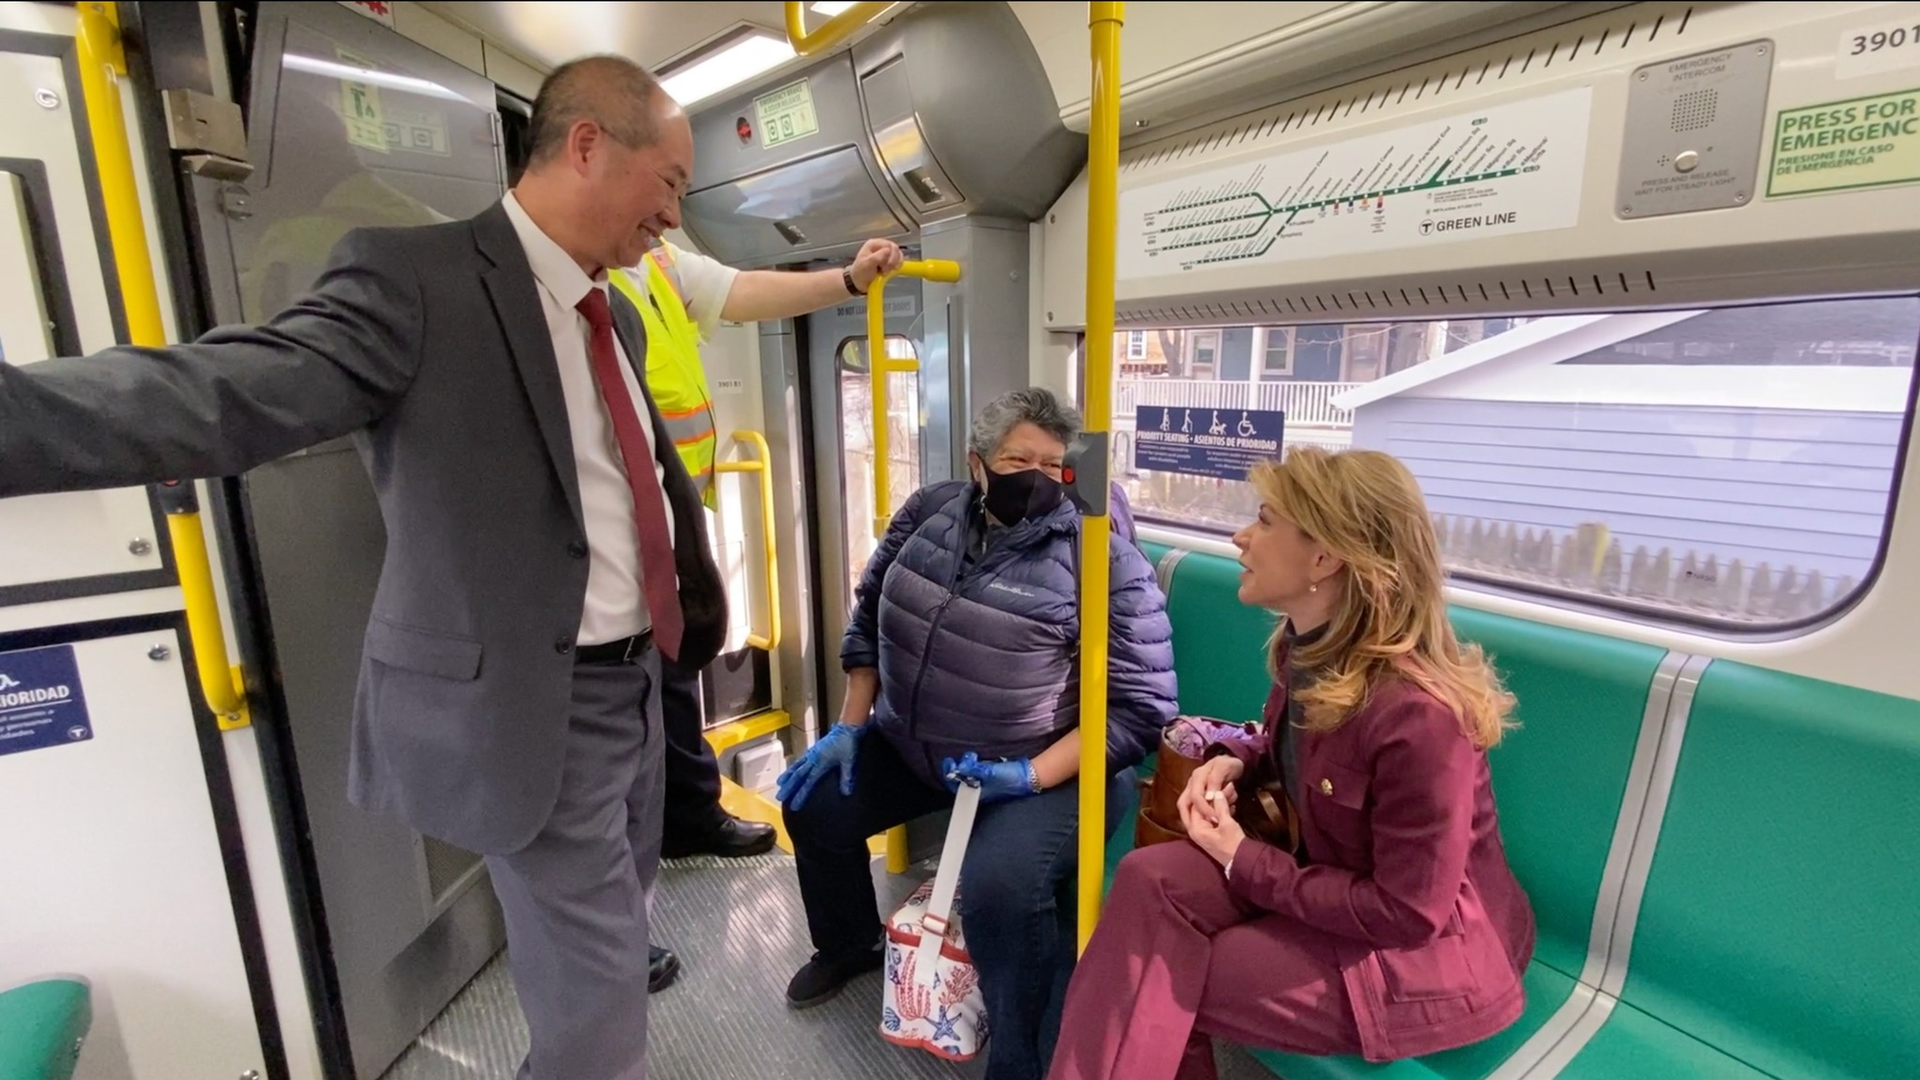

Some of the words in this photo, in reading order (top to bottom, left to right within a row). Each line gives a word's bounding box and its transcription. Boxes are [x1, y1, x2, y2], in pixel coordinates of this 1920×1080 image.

[1851, 24, 1920, 56] 3901
[1668, 53, 1734, 74] EMERGENCY
[1672, 64, 1727, 82] INTERCOM
[1782, 106, 1858, 134] PRESS
[1863, 98, 1917, 121] FOR
[1779, 117, 1920, 152] EMERGENC
[1776, 150, 1836, 166] PRESIONE
[1838, 147, 1856, 159] EN
[1858, 143, 1895, 156] CASO
[1775, 165, 1794, 176] DE
[1794, 155, 1876, 174] EMERGENCIA
[1634, 188, 1654, 197] WAIT
[1655, 184, 1673, 193] FOR
[1674, 180, 1708, 191] STEADY
[1709, 177, 1737, 187] LIGHT
[1641, 176, 1669, 187] PRESS
[1670, 175, 1688, 184] AND
[1690, 168, 1730, 181] RELEASE
[1436, 216, 1482, 232] GREEN
[1485, 211, 1517, 226] LINE
[1136, 430, 1164, 441] PRIORITY
[1164, 432, 1190, 444] SEATING
[1193, 434, 1226, 447] ASIENTOS
[1226, 436, 1236, 448] DE
[1236, 437, 1277, 451] PRIORIDAD
[0, 685, 70, 708] IORIDAD
